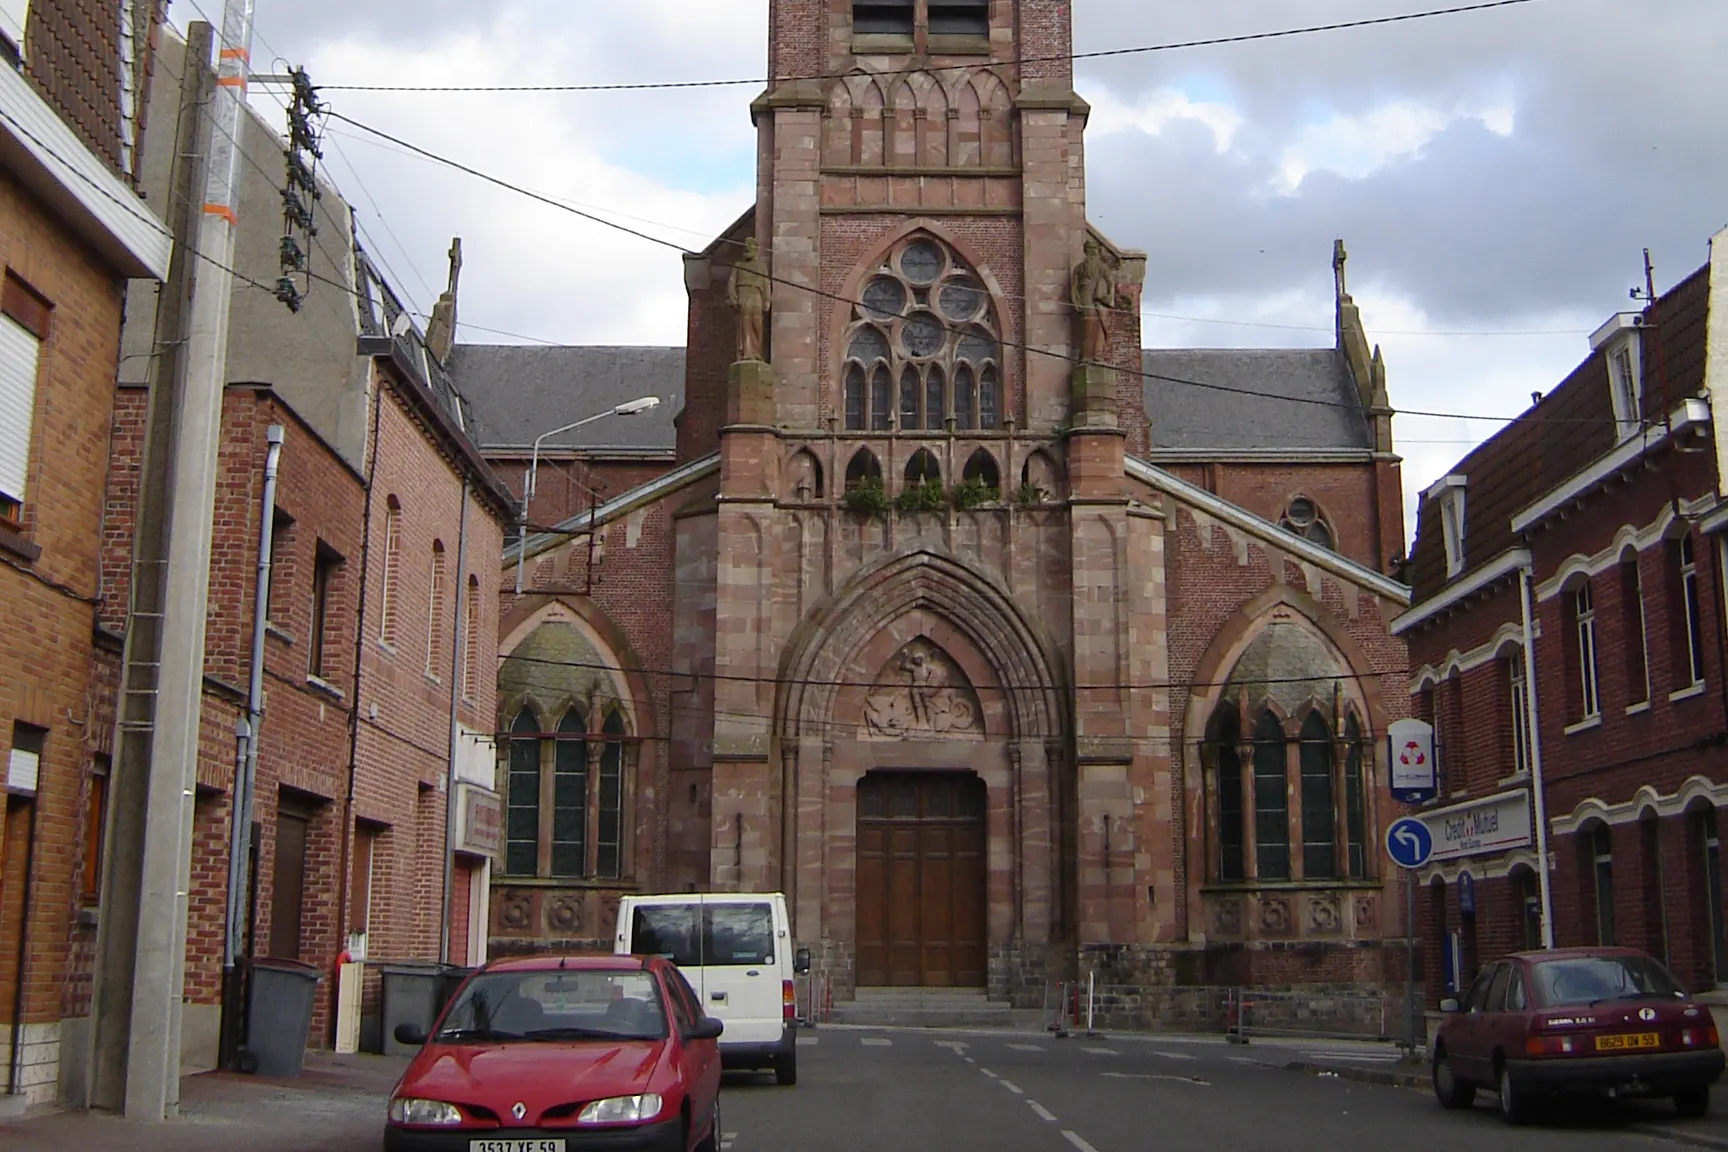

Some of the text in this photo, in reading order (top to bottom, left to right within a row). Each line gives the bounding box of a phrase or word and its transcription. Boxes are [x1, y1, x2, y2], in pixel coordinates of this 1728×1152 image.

[1445, 809, 1498, 841] Crédit Mutuel
[540, 1141, 556, 1152] 59
